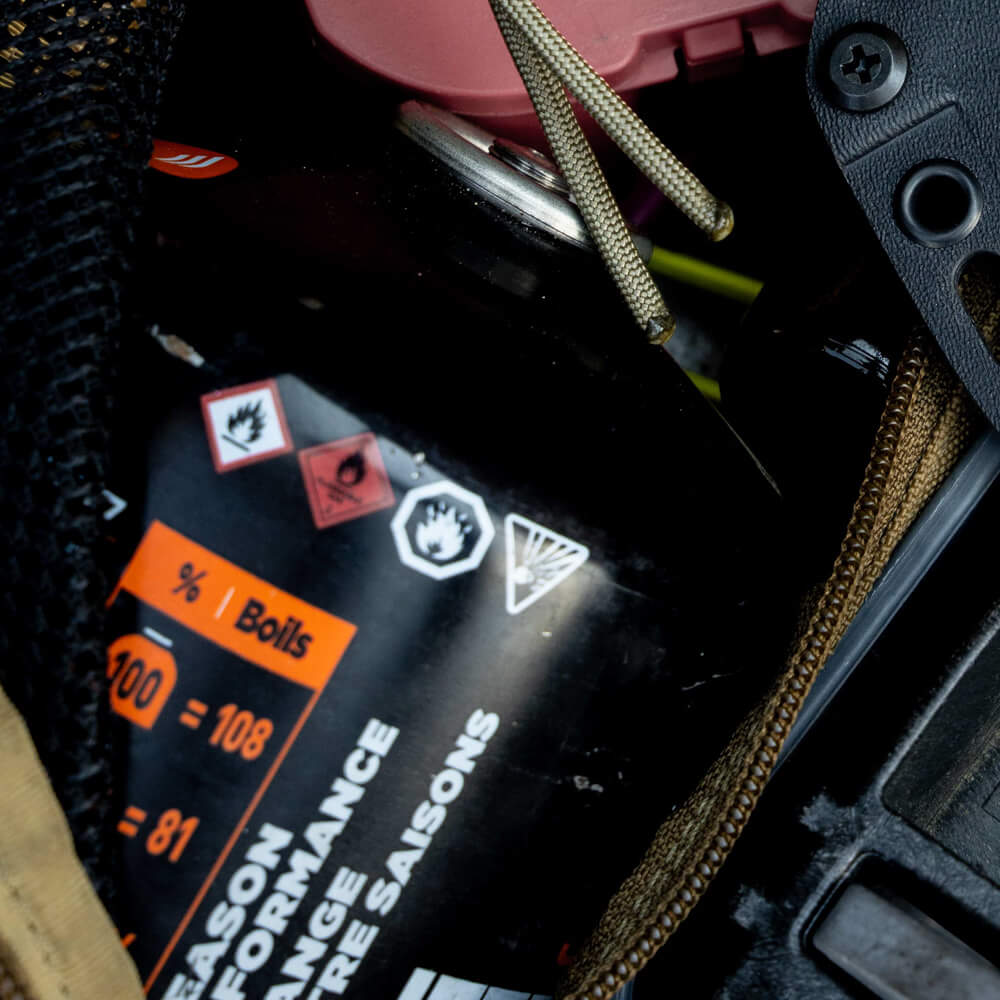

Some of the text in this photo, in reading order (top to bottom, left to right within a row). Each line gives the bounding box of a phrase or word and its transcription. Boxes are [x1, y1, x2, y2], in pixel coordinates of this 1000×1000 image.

[171, 562, 314, 660] % Boils
[110, 651, 163, 710] 100
[209, 703, 274, 760] 108
[145, 808, 199, 863] 81
[209, 718, 400, 1000] FORMANCE
[306, 708, 501, 1000] RE SAISONS
